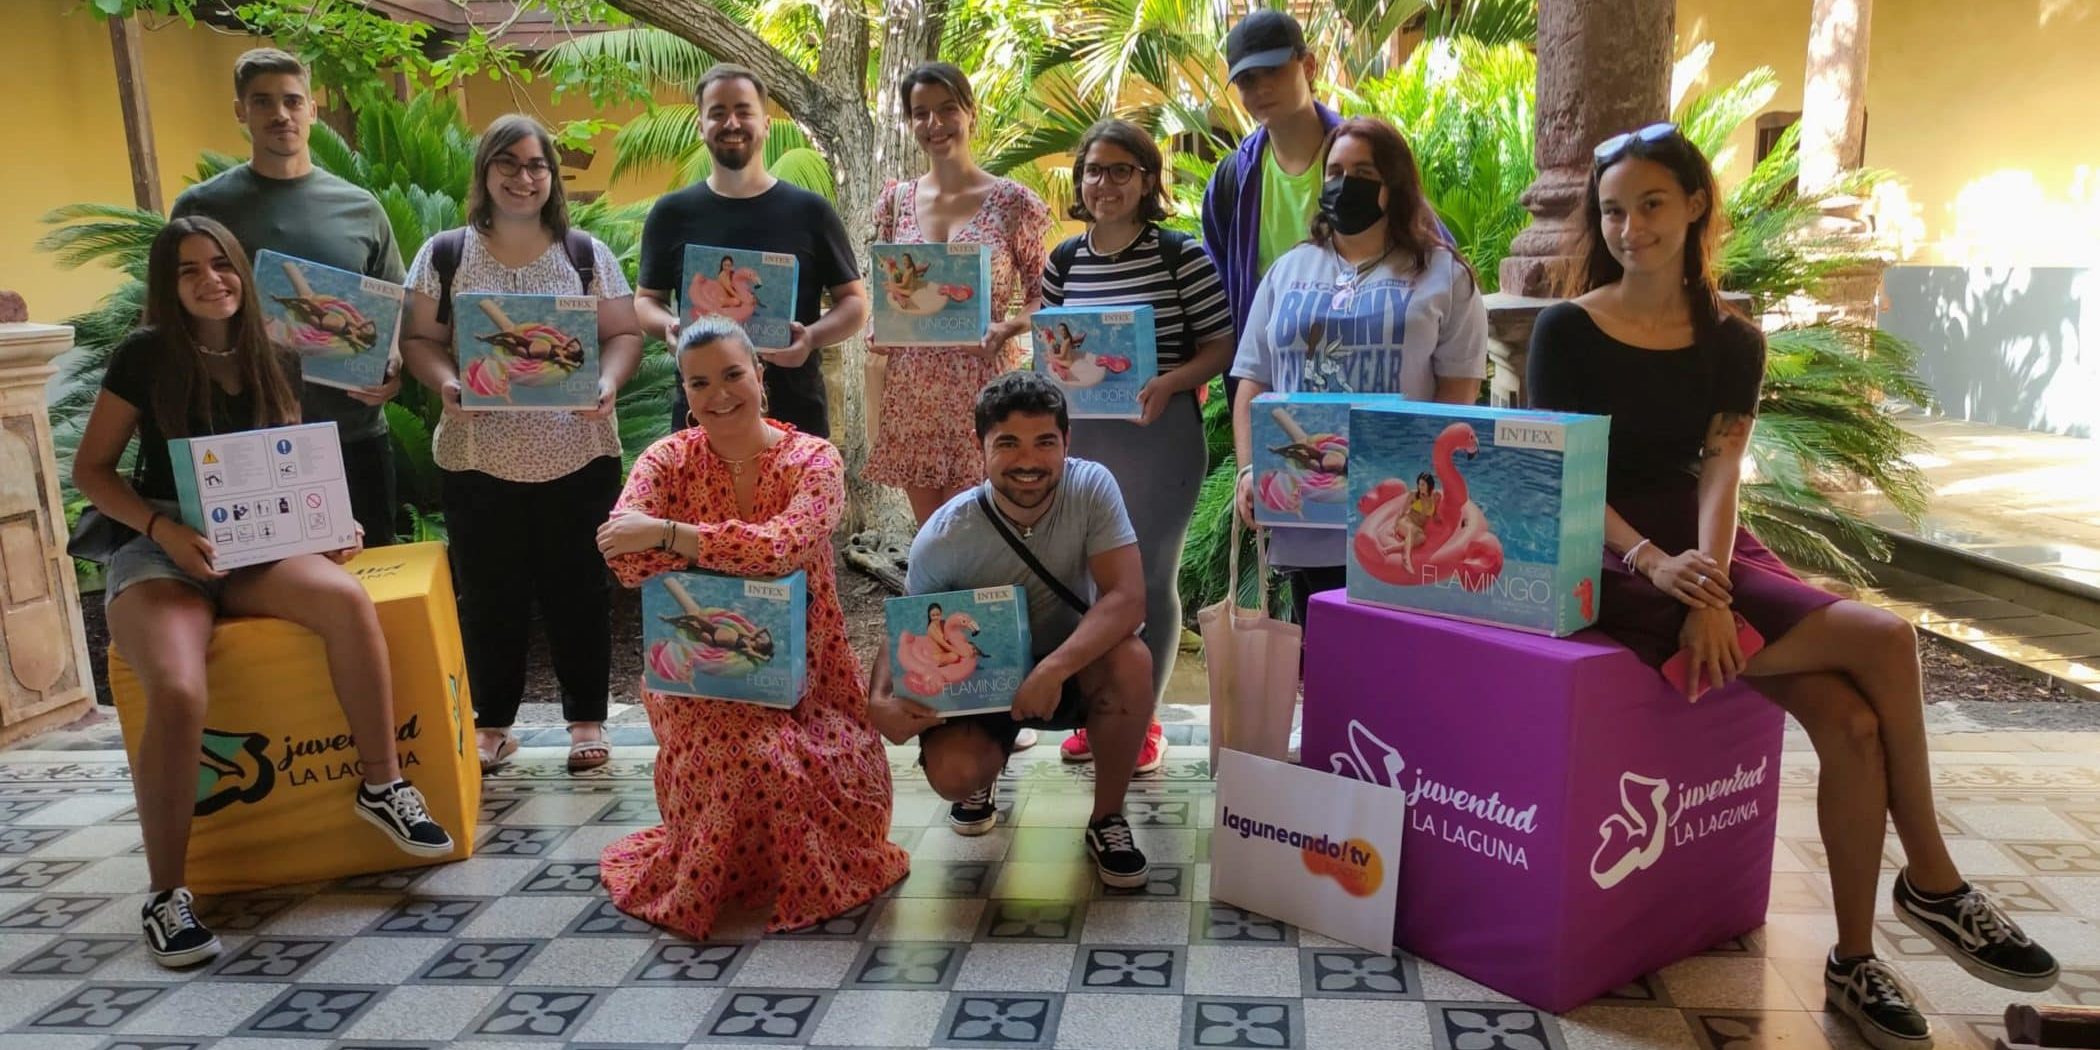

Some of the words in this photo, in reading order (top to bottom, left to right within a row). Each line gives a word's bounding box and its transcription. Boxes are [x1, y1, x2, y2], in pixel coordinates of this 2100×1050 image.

[559, 299, 592, 308] INTEX
[1104, 313, 1131, 322] INTEX
[1275, 288, 1414, 348] BUNNY
[1500, 426, 1553, 445] INTEX
[747, 585, 784, 597] INTEX
[977, 589, 1009, 601] INTEX
[1421, 564, 1551, 605] FLAMINGO
[942, 675, 1020, 696] FLAMINGO
[288, 769, 318, 786] LA
[1674, 756, 1769, 822] juventud
[1406, 767, 1538, 835] juventud
[1673, 823, 1695, 848] LA
[1699, 801, 1760, 842] LAGUNA
[1411, 808, 1436, 838] LA
[1442, 819, 1529, 871] LAGUNA
